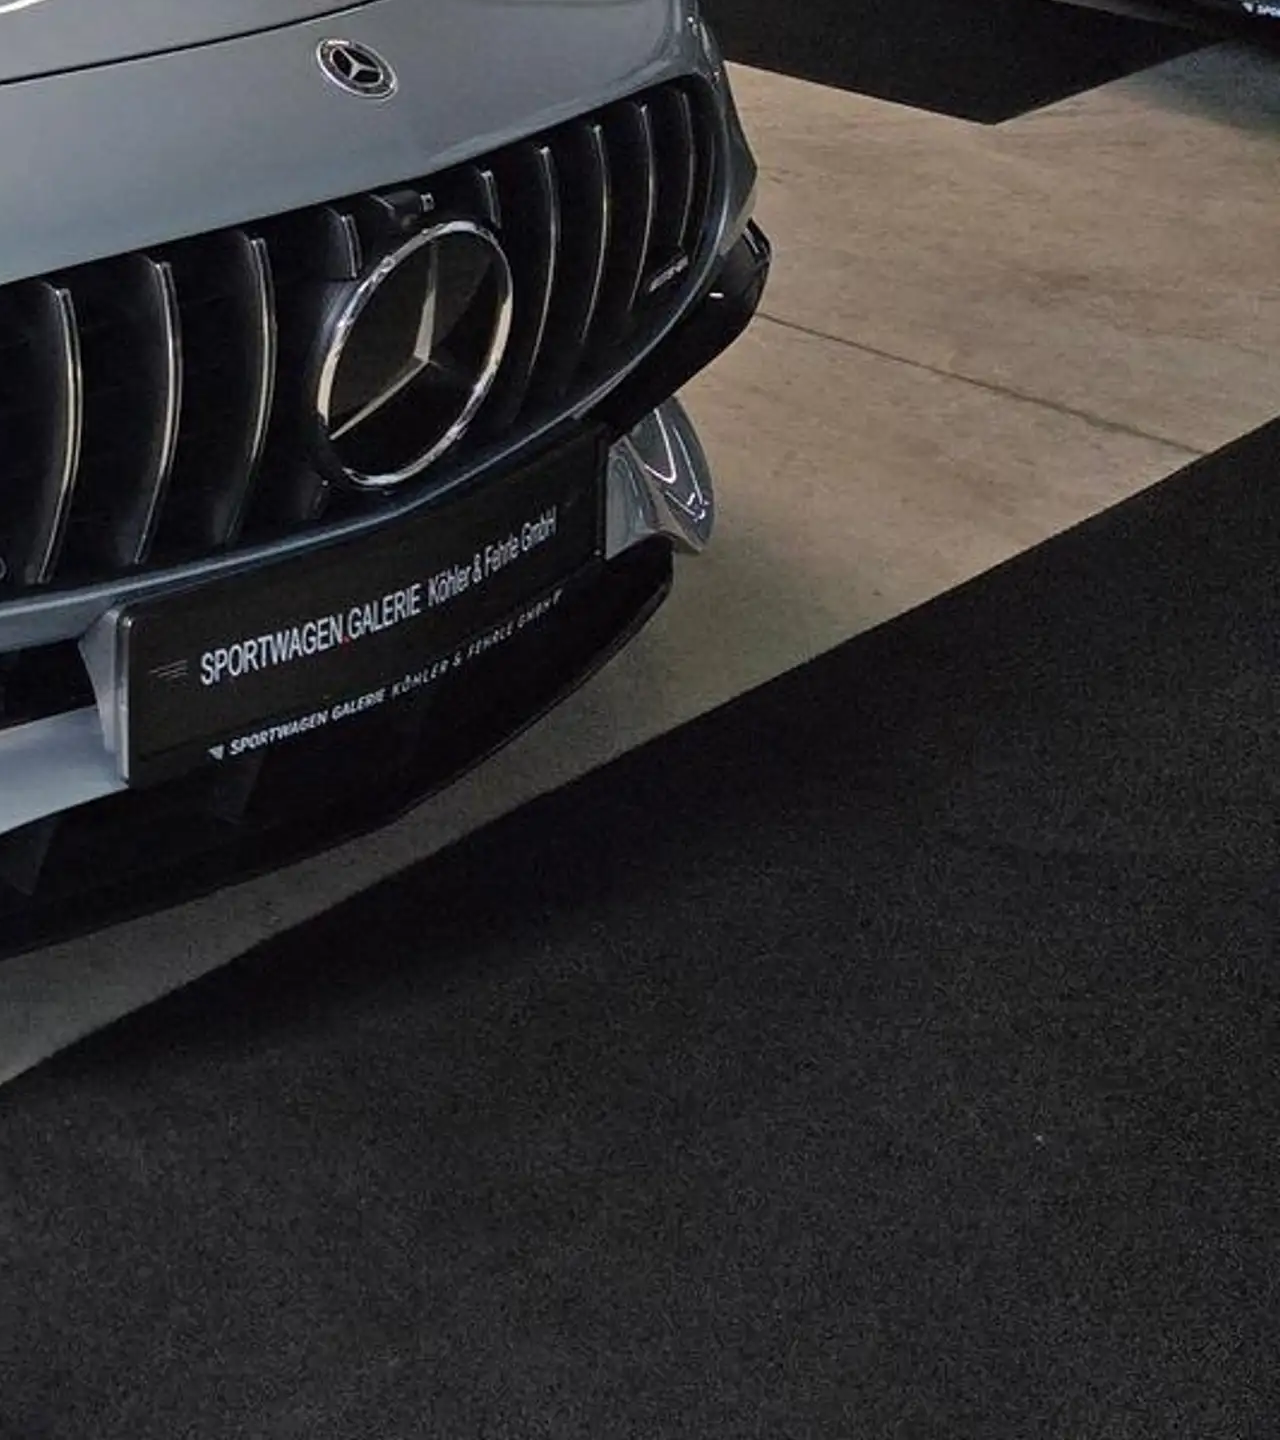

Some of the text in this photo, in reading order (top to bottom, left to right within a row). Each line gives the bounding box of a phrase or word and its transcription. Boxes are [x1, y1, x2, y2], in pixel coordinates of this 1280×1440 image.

[427, 562, 471, 608] Köhler
[473, 553, 483, 584] &
[484, 532, 520, 577] Fehrle
[521, 504, 557, 552] GmbH
[229, 710, 329, 756] SPORTWAGEN
[331, 687, 386, 721] GALERIE
[391, 658, 449, 700] KÖHLER
[452, 650, 462, 667] &
